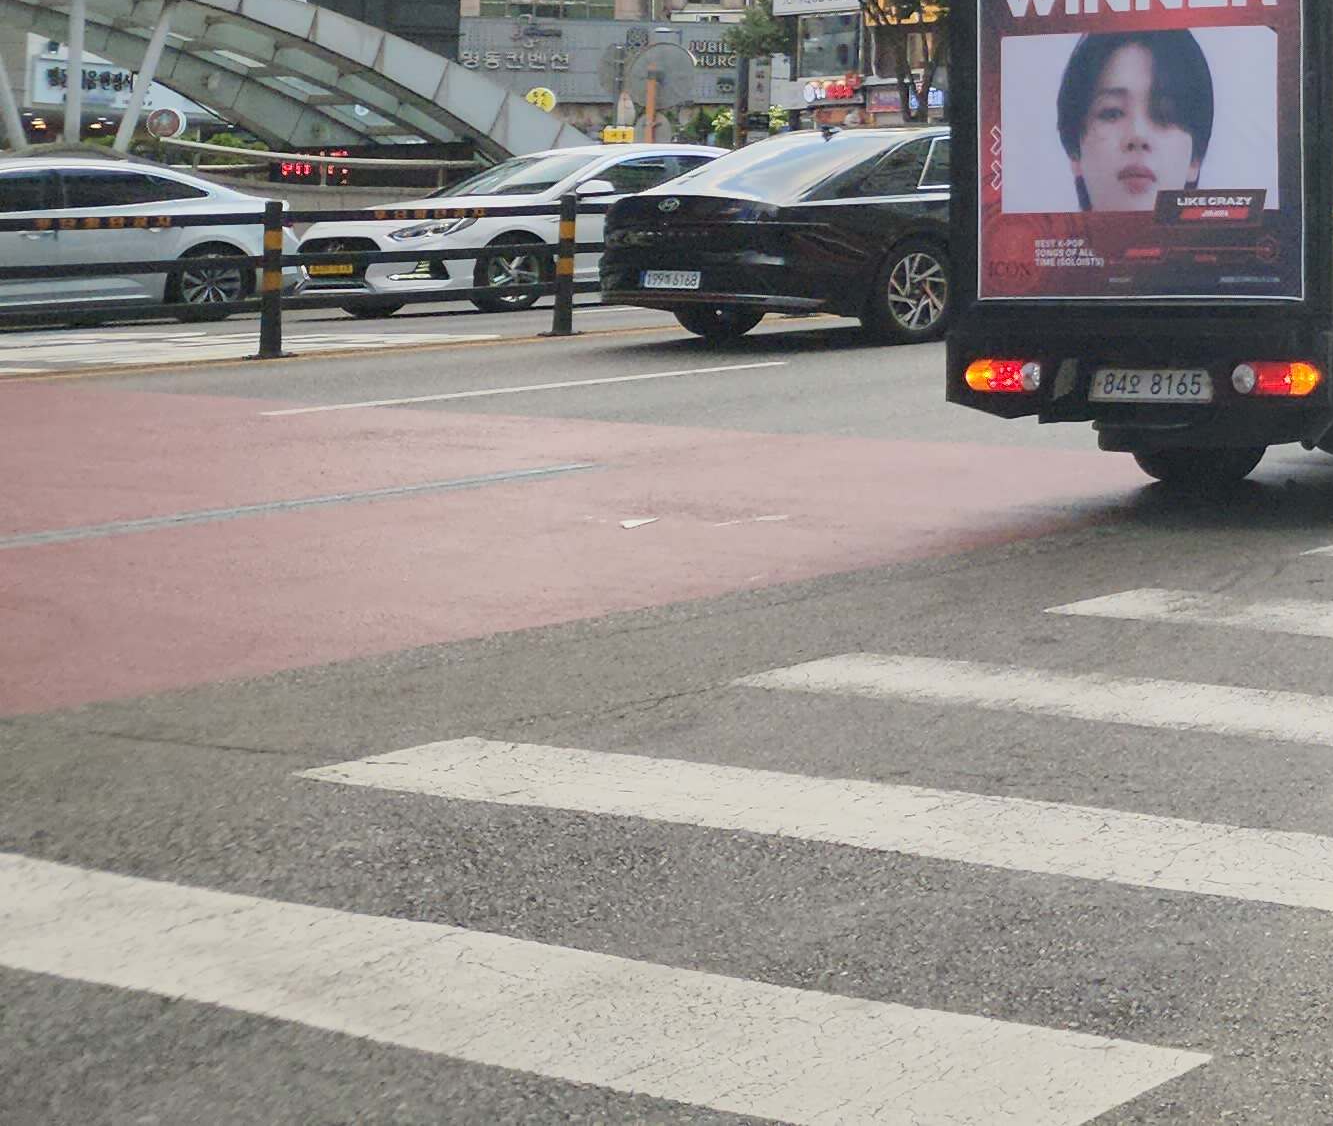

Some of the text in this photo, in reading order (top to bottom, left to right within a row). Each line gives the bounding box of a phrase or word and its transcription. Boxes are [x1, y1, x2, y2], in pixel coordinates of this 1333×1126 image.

[1176, 196, 1253, 206] LIKE CRAZY
[1103, 372, 1202, 396] 84오 8165
